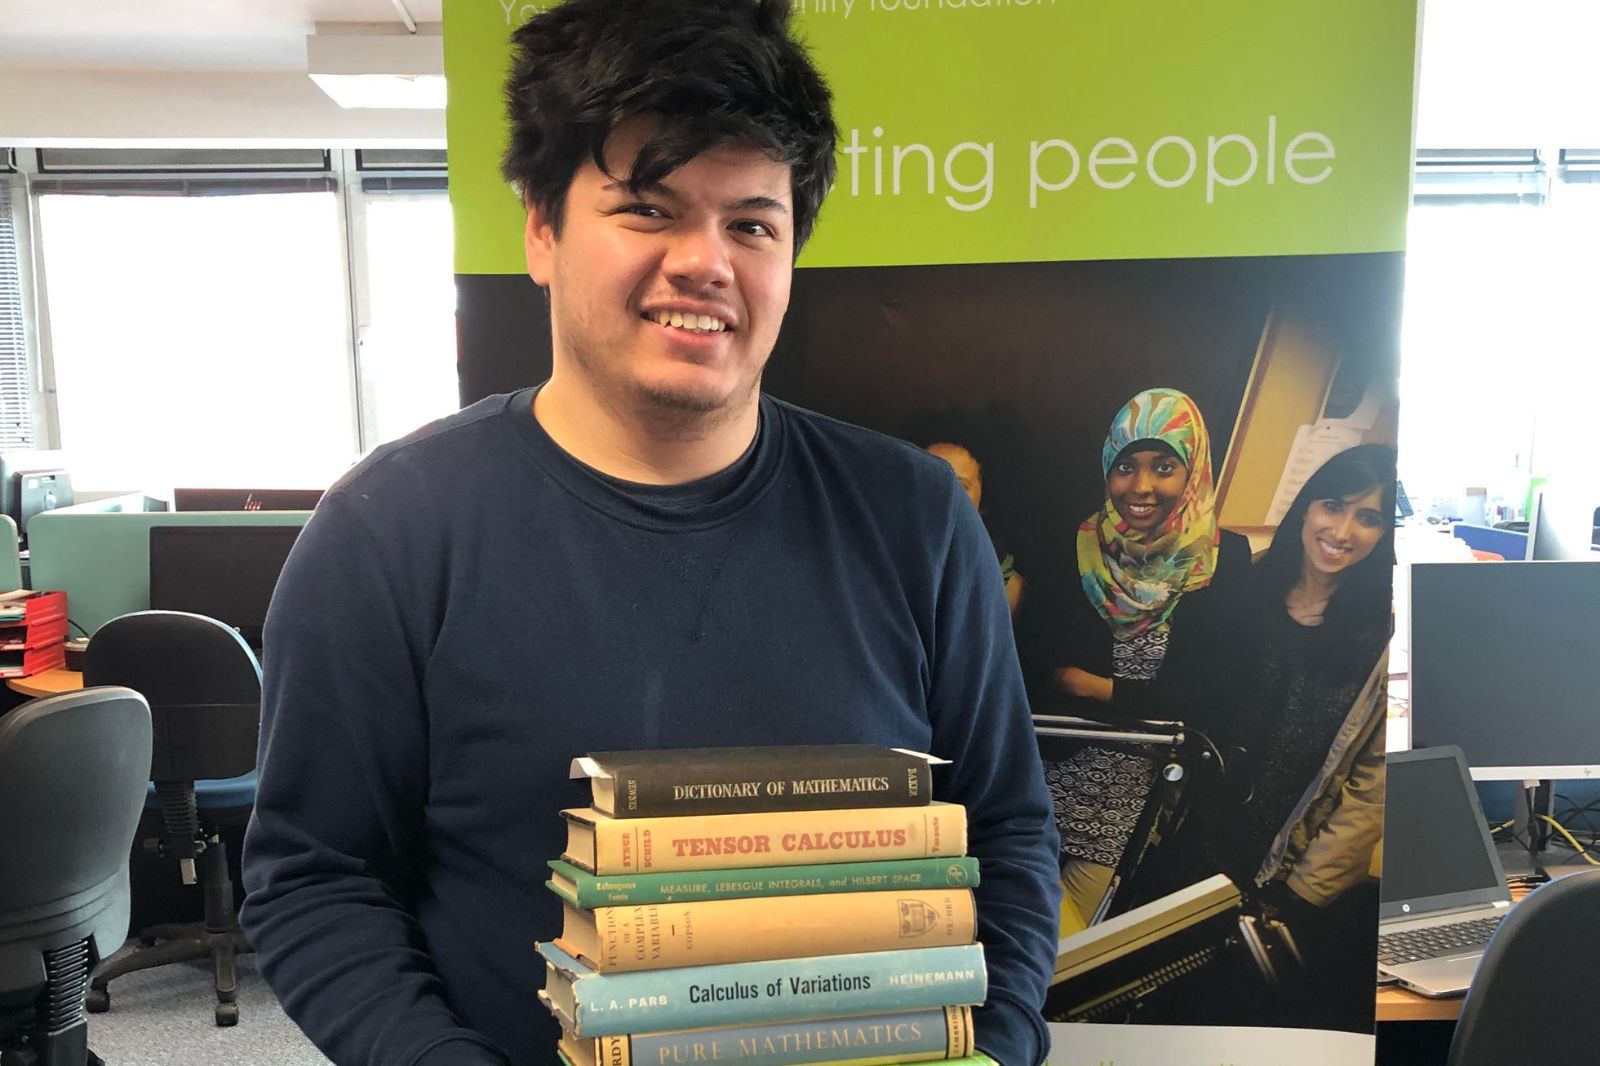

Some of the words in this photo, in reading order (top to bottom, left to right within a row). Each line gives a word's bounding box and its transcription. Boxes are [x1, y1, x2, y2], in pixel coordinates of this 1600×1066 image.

[843, 126, 994, 212] ting
[1029, 115, 1336, 208] people
[672, 782, 762, 800] DICTIONARY
[767, 780, 786, 796] OF
[792, 777, 889, 796] MATHEMATICS
[643, 829, 652, 869] SCHILD
[672, 834, 771, 857] TENSOR
[781, 829, 906, 852] CALCULUS
[660, 883, 711, 895] MEASURE,
[715, 881, 764, 893] LEBESGUE
[768, 878, 824, 890] INTEGRALS,
[829, 876, 848, 887] and
[852, 874, 888, 886] HILBERT
[892, 873, 922, 884] SPACE
[634, 906, 646, 961] COMPLEX
[684, 911, 694, 950] COPSON
[689, 981, 759, 1004] Calculus
[766, 978, 783, 997] of
[789, 973, 871, 995] Variations
[889, 969, 975, 986] HEINEMANN
[590, 1002, 604, 1012] L.
[609, 1000, 624, 1010] A.
[629, 995, 668, 1009] PARS
[611, 1036, 622, 1066] RDY
[659, 1040, 723, 1065] PURE
[738, 1022, 922, 1057] MATHEMATICS
